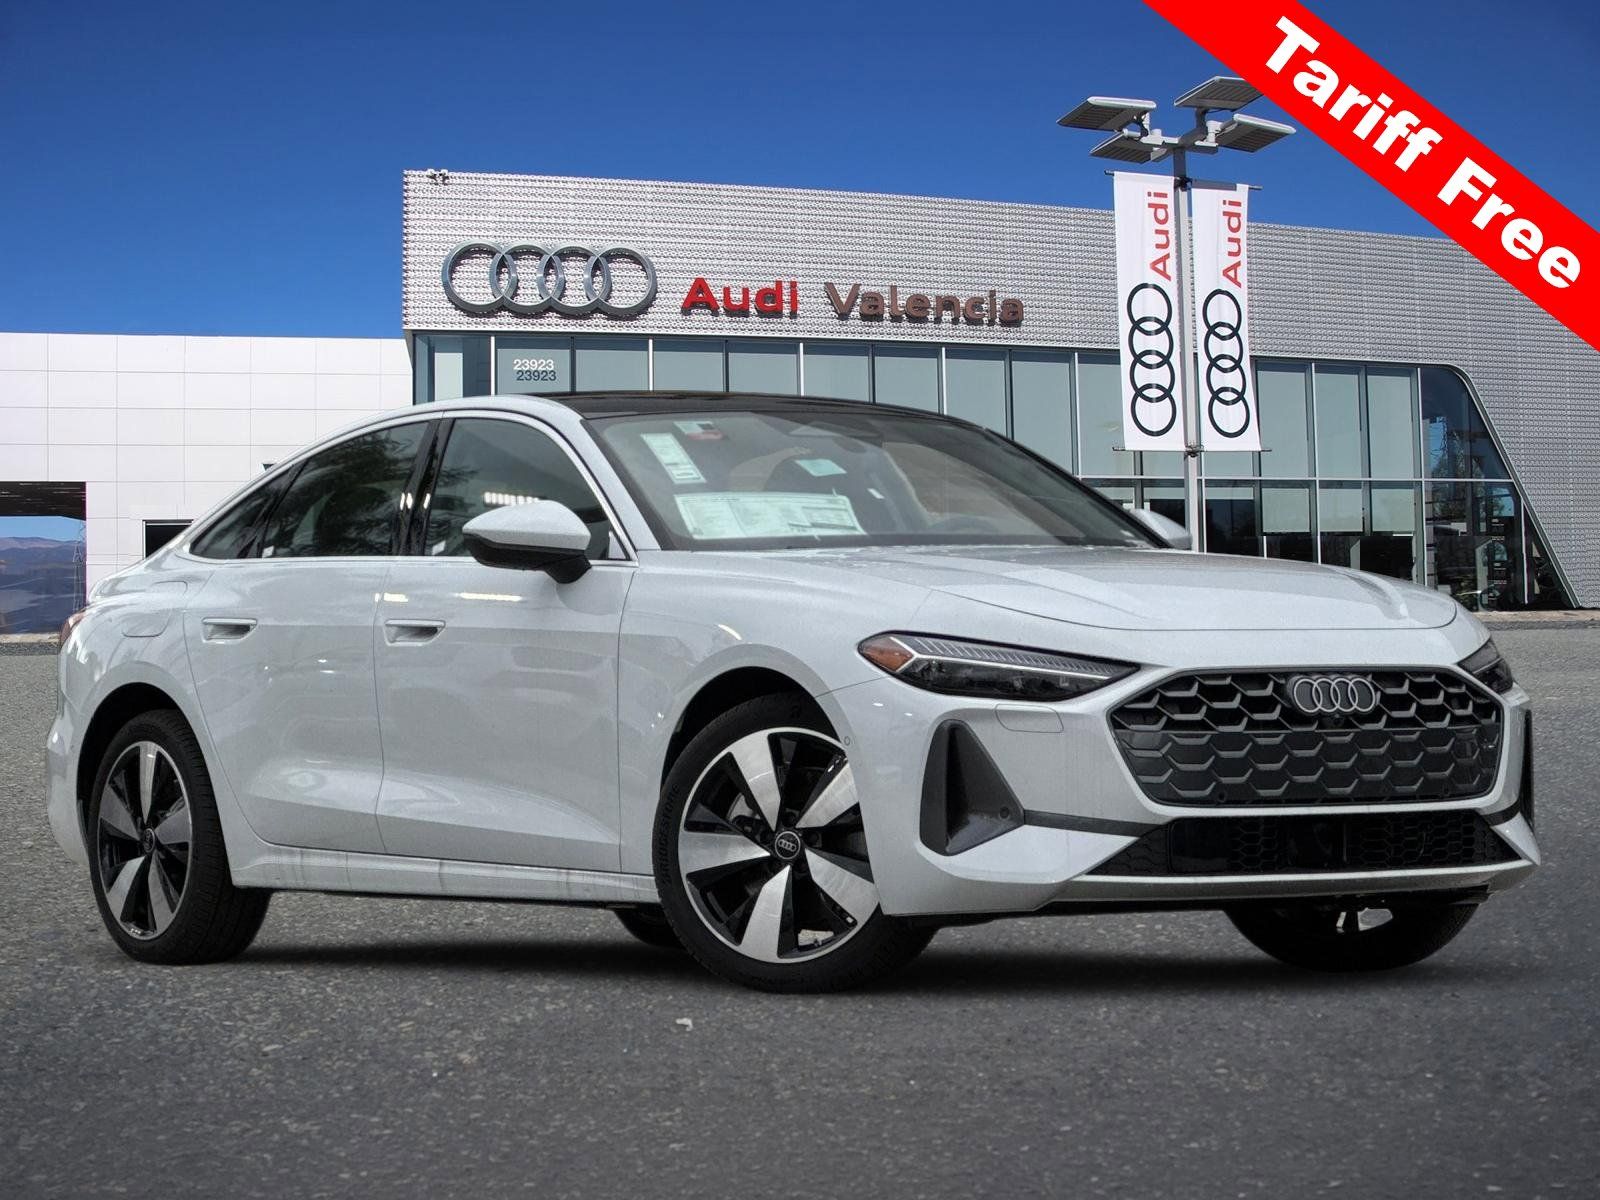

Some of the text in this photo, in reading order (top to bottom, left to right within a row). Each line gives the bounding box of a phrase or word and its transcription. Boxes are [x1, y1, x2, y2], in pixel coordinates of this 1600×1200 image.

[1147, 190, 1172, 281] Audi
[1222, 200, 1244, 288] Audi
[681, 276, 1025, 325] Audi Valencia
[513, 359, 554, 370] 23923
[516, 370, 557, 381] 23923
